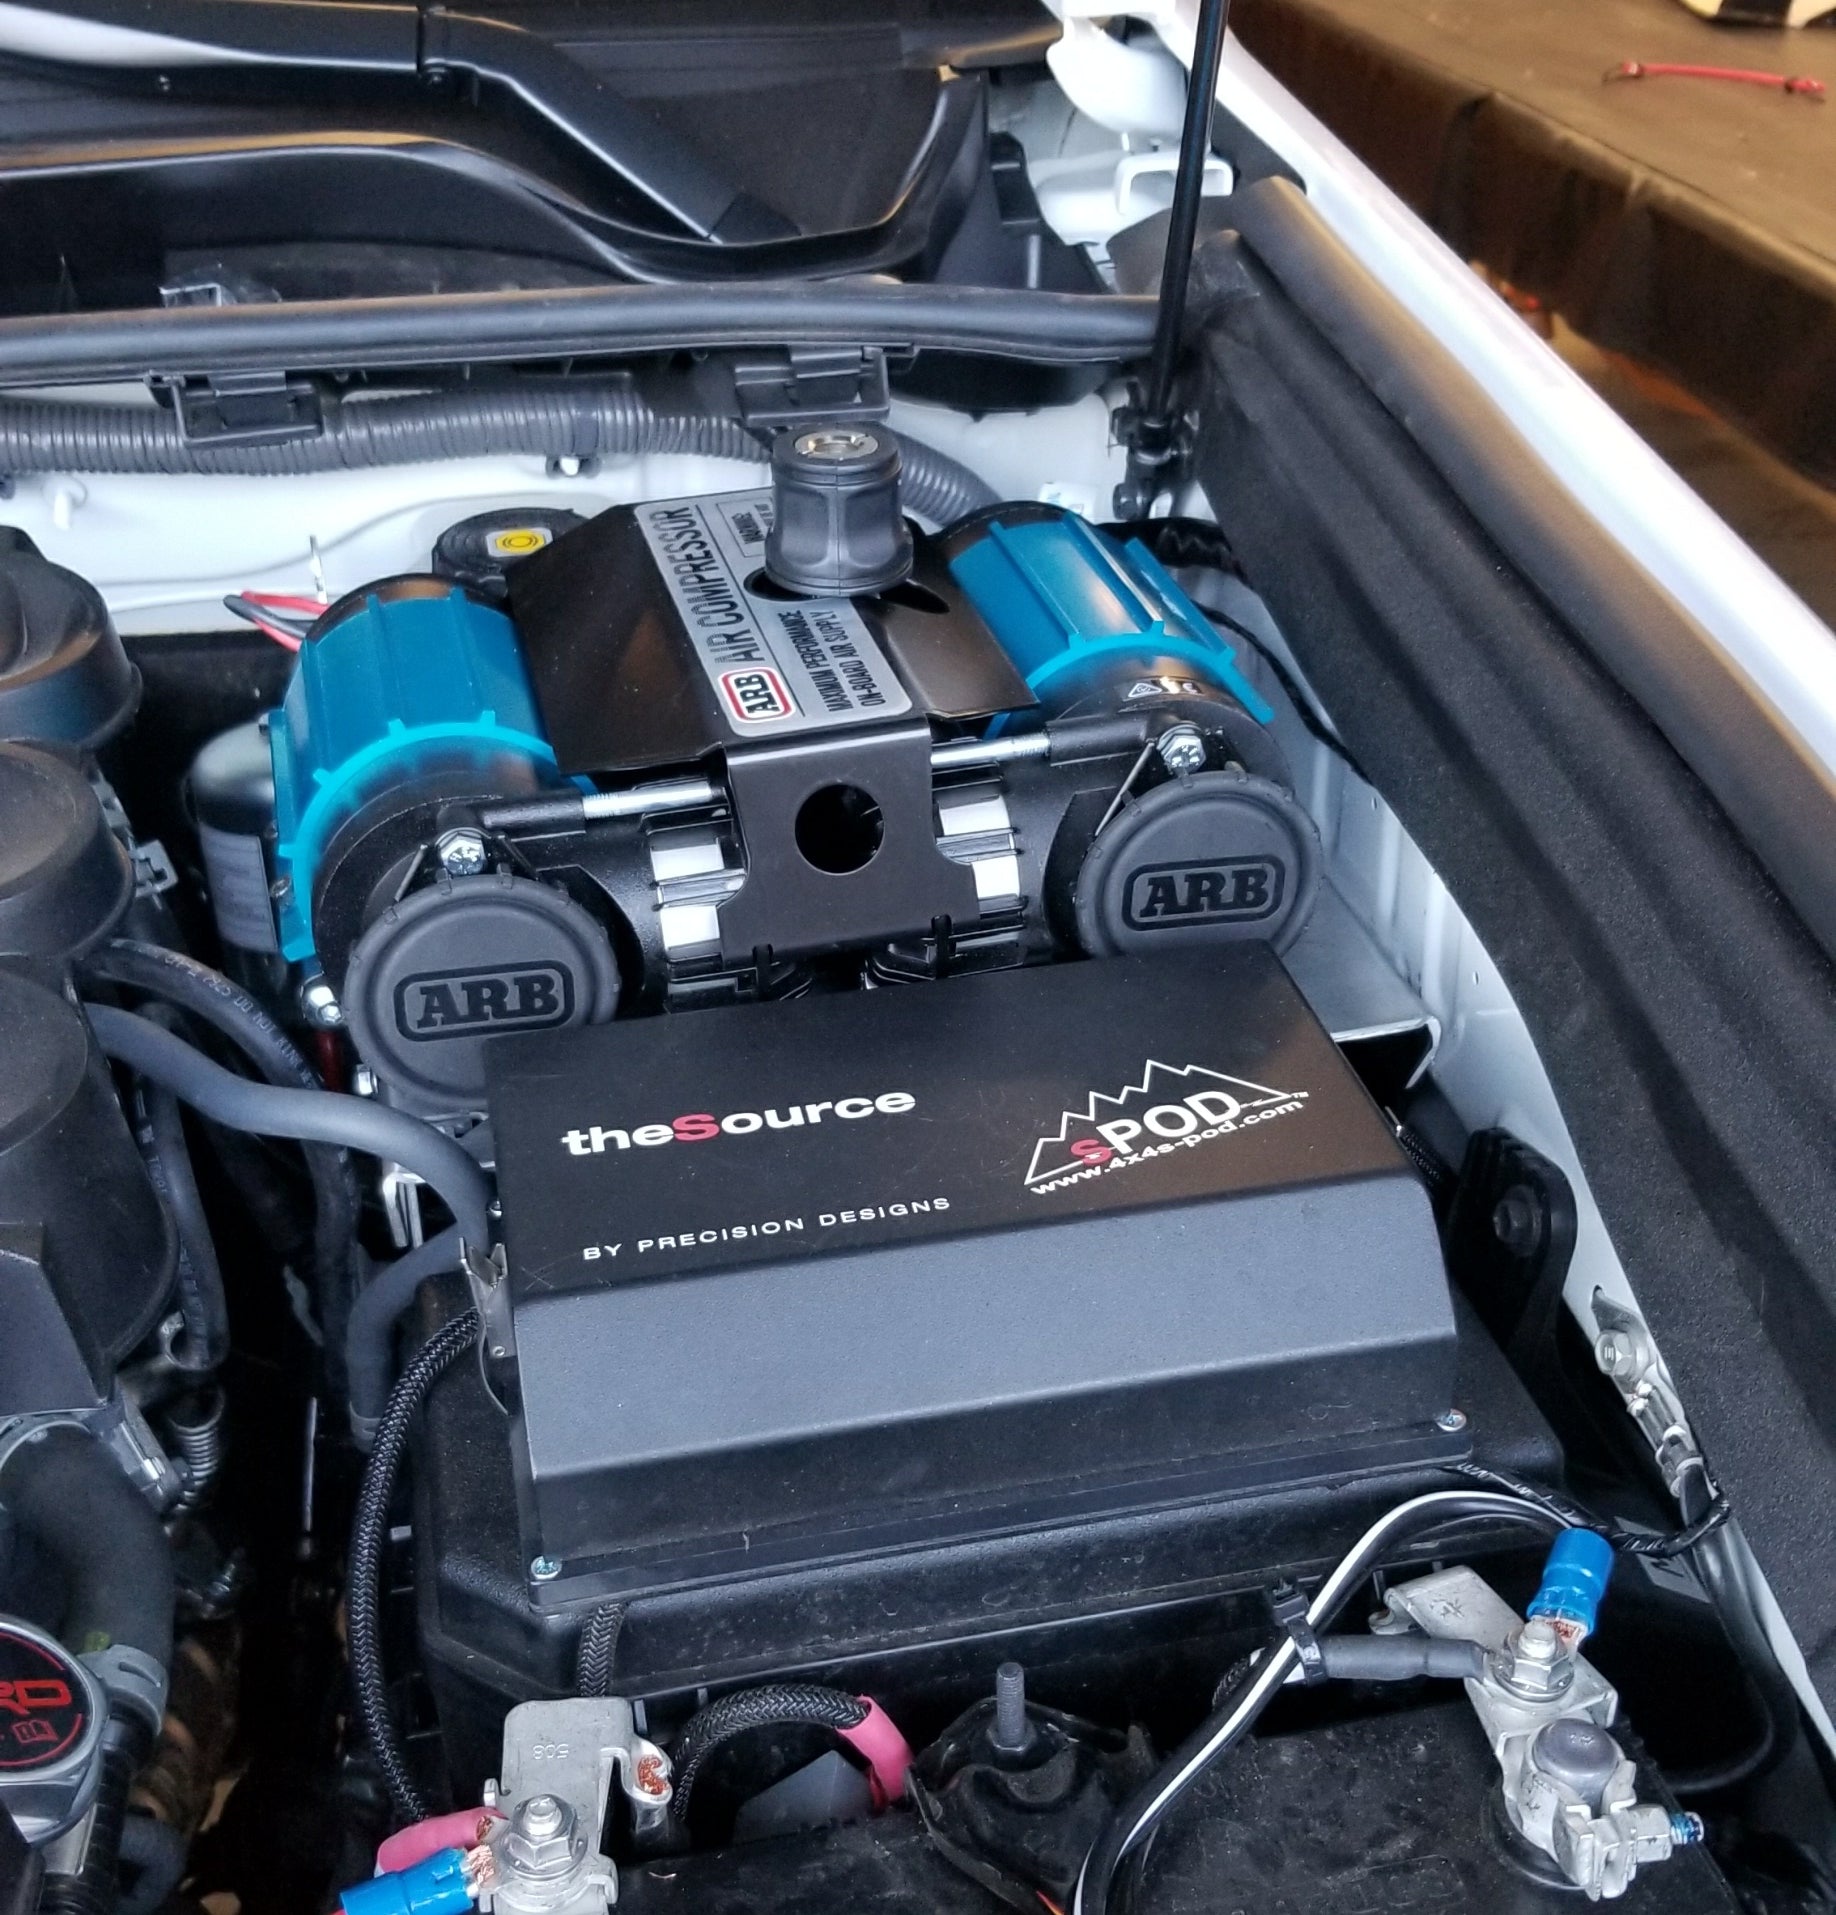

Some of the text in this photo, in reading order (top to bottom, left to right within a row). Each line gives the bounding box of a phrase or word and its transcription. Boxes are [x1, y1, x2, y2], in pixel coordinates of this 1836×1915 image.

[649, 507, 780, 714] ARB AIR COMPRESSOR
[777, 609, 854, 711] MAXIMUM PERFORMANCE
[810, 610, 886, 706] ON-BOARD AIR SUPPLY
[1140, 868, 1268, 918] ARB
[417, 974, 559, 1029] ARB
[560, 1091, 916, 1156] theSource
[1030, 1100, 1304, 1195] www.4x4s-pod.com
[583, 1197, 951, 1260] BY PRECISION DESIGNS
